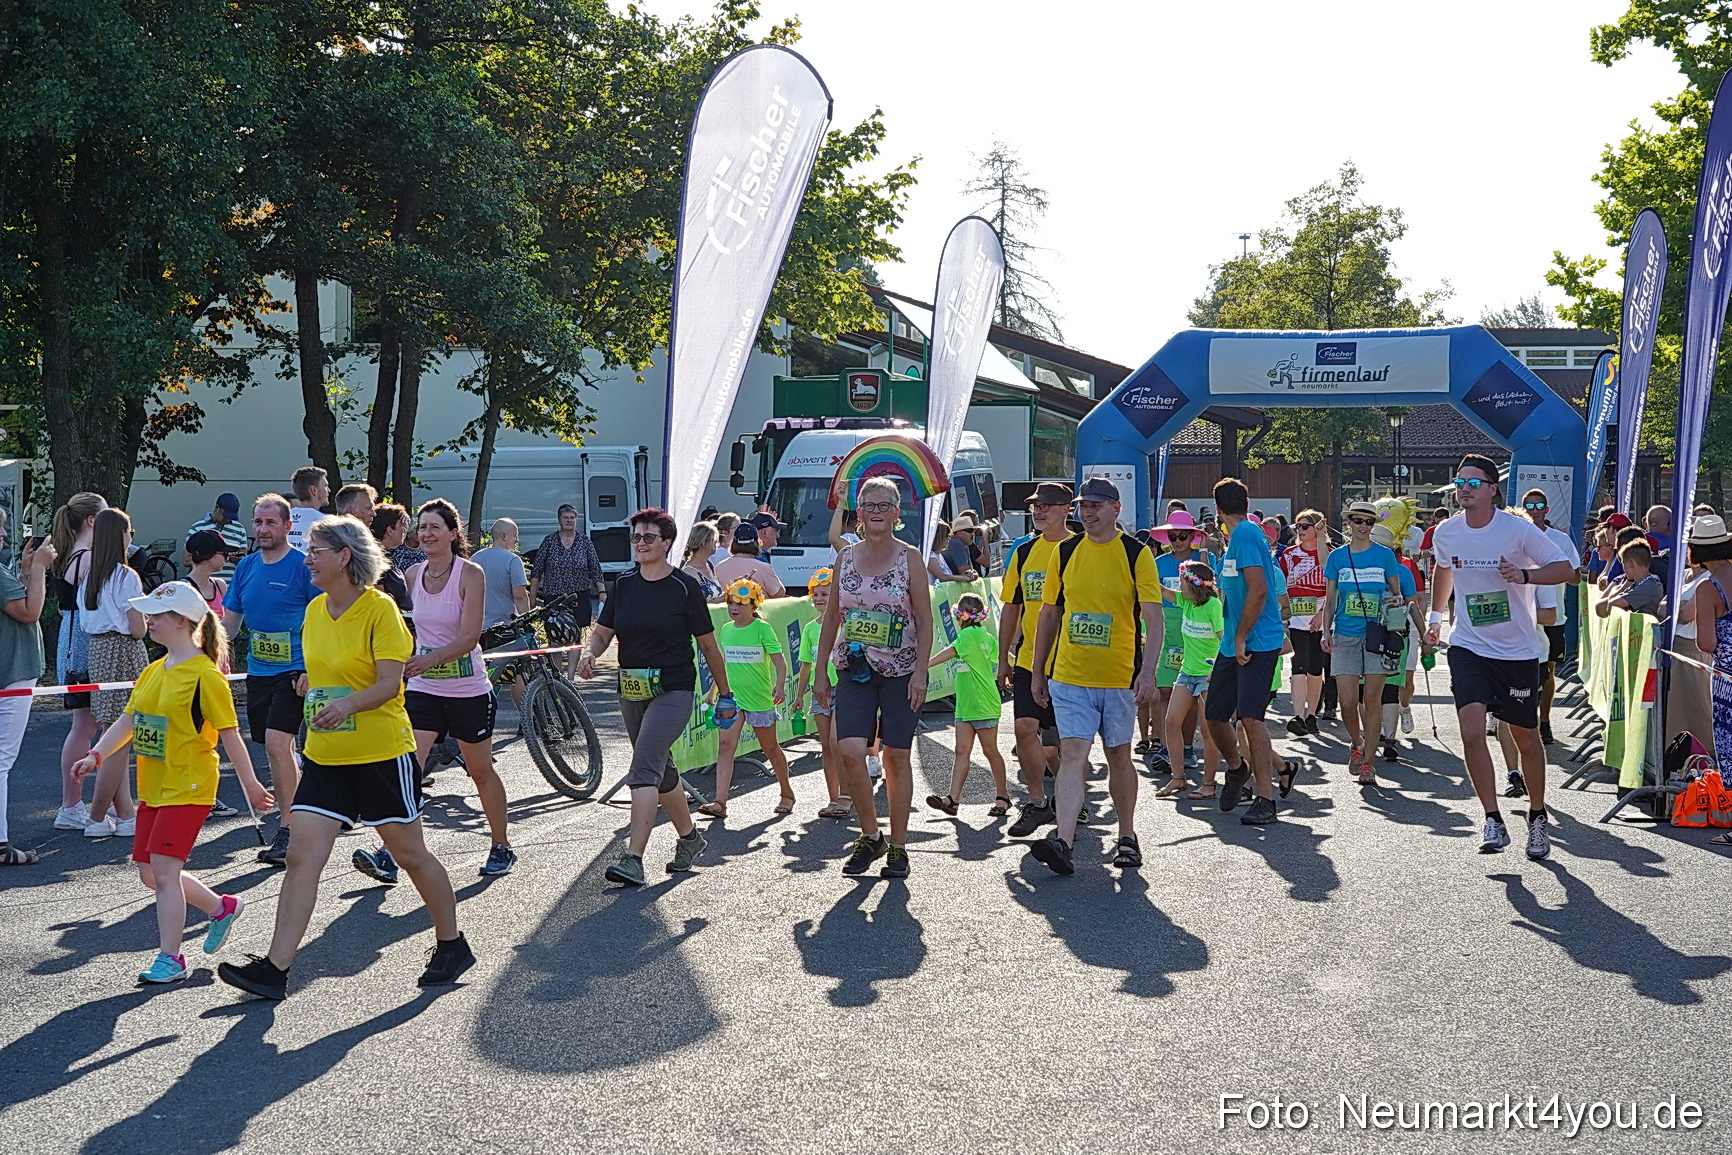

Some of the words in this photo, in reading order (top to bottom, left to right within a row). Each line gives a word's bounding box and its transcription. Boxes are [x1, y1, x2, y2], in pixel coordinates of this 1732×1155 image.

[725, 84, 790, 228] Fischer
[756, 104, 802, 221] AUTOMOBILE
[954, 243, 987, 338] Fischer
[1634, 235, 1656, 336] Fischer
[1324, 350, 1354, 358] Fischer
[1301, 364, 1391, 382] firmenlauf
[1301, 382, 1338, 390] neumarkt
[1130, 394, 1179, 405] Fischer
[682, 307, 755, 510] www.fischer-automobile.de
[787, 456, 828, 466] abavent
[1294, 602, 1314, 611] 1115
[1476, 602, 1499, 616] 182
[855, 620, 879, 635] 259
[1074, 622, 1104, 636] 1269
[259, 641, 280, 654] 839
[1170, 654, 1183, 664] 14
[622, 679, 641, 692] 268
[1509, 687, 1532, 697] PUMA
[135, 726, 158, 745] 1254
